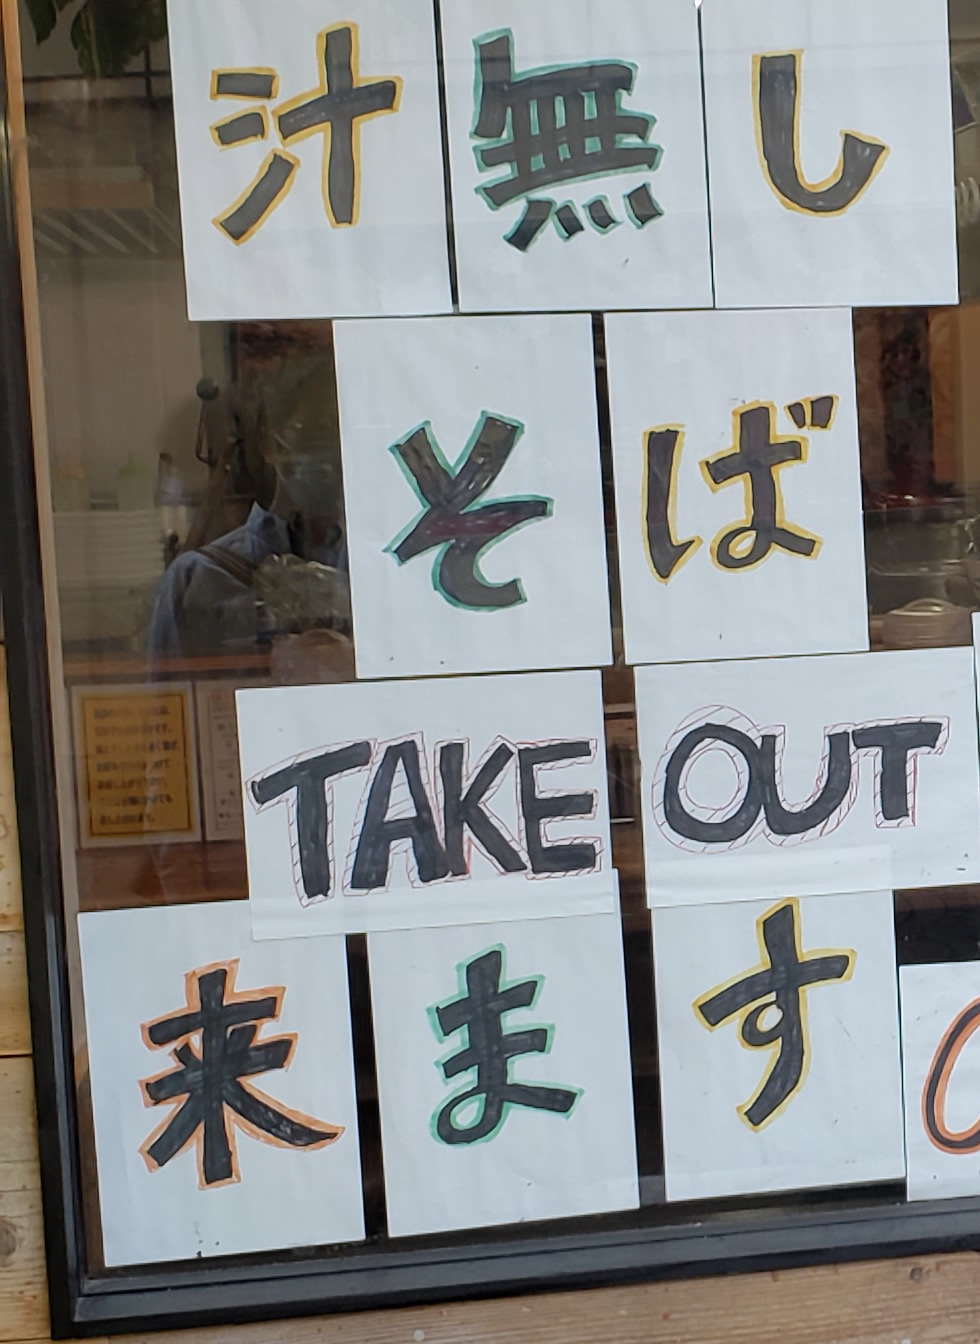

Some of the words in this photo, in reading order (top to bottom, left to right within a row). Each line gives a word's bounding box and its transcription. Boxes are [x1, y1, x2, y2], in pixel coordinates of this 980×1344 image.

[209, 18, 890, 252] 汁無し
[382, 392, 839, 612] そば
[246, 728, 603, 906] TAKE
[652, 705, 952, 854] OUT
[139, 895, 857, 1192] 来ます
